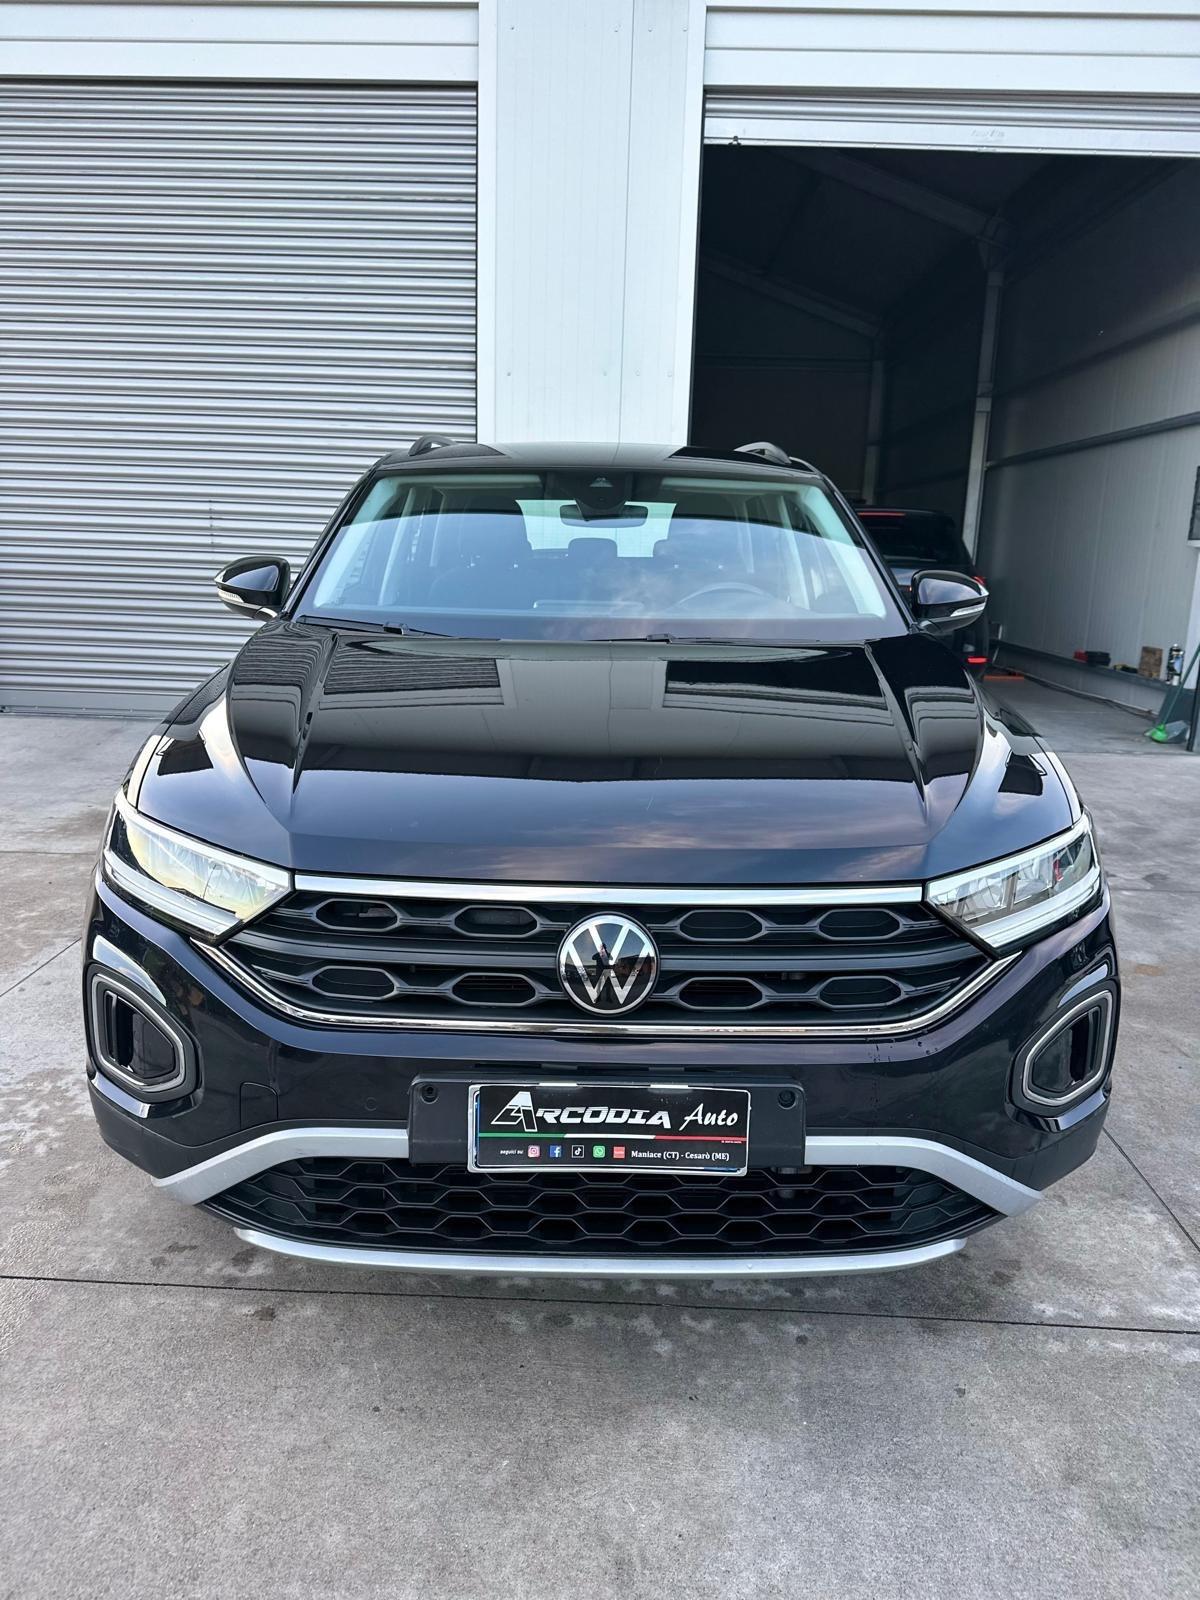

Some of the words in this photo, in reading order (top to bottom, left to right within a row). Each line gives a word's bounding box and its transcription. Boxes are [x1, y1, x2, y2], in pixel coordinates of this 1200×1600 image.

[679, 1103, 738, 1131] Auto
[631, 1150, 662, 1159] Maniace
[663, 1151, 680, 1160] (CT)
[685, 1152, 710, 1160] Cesarò
[711, 1152, 730, 1161] (ME)
